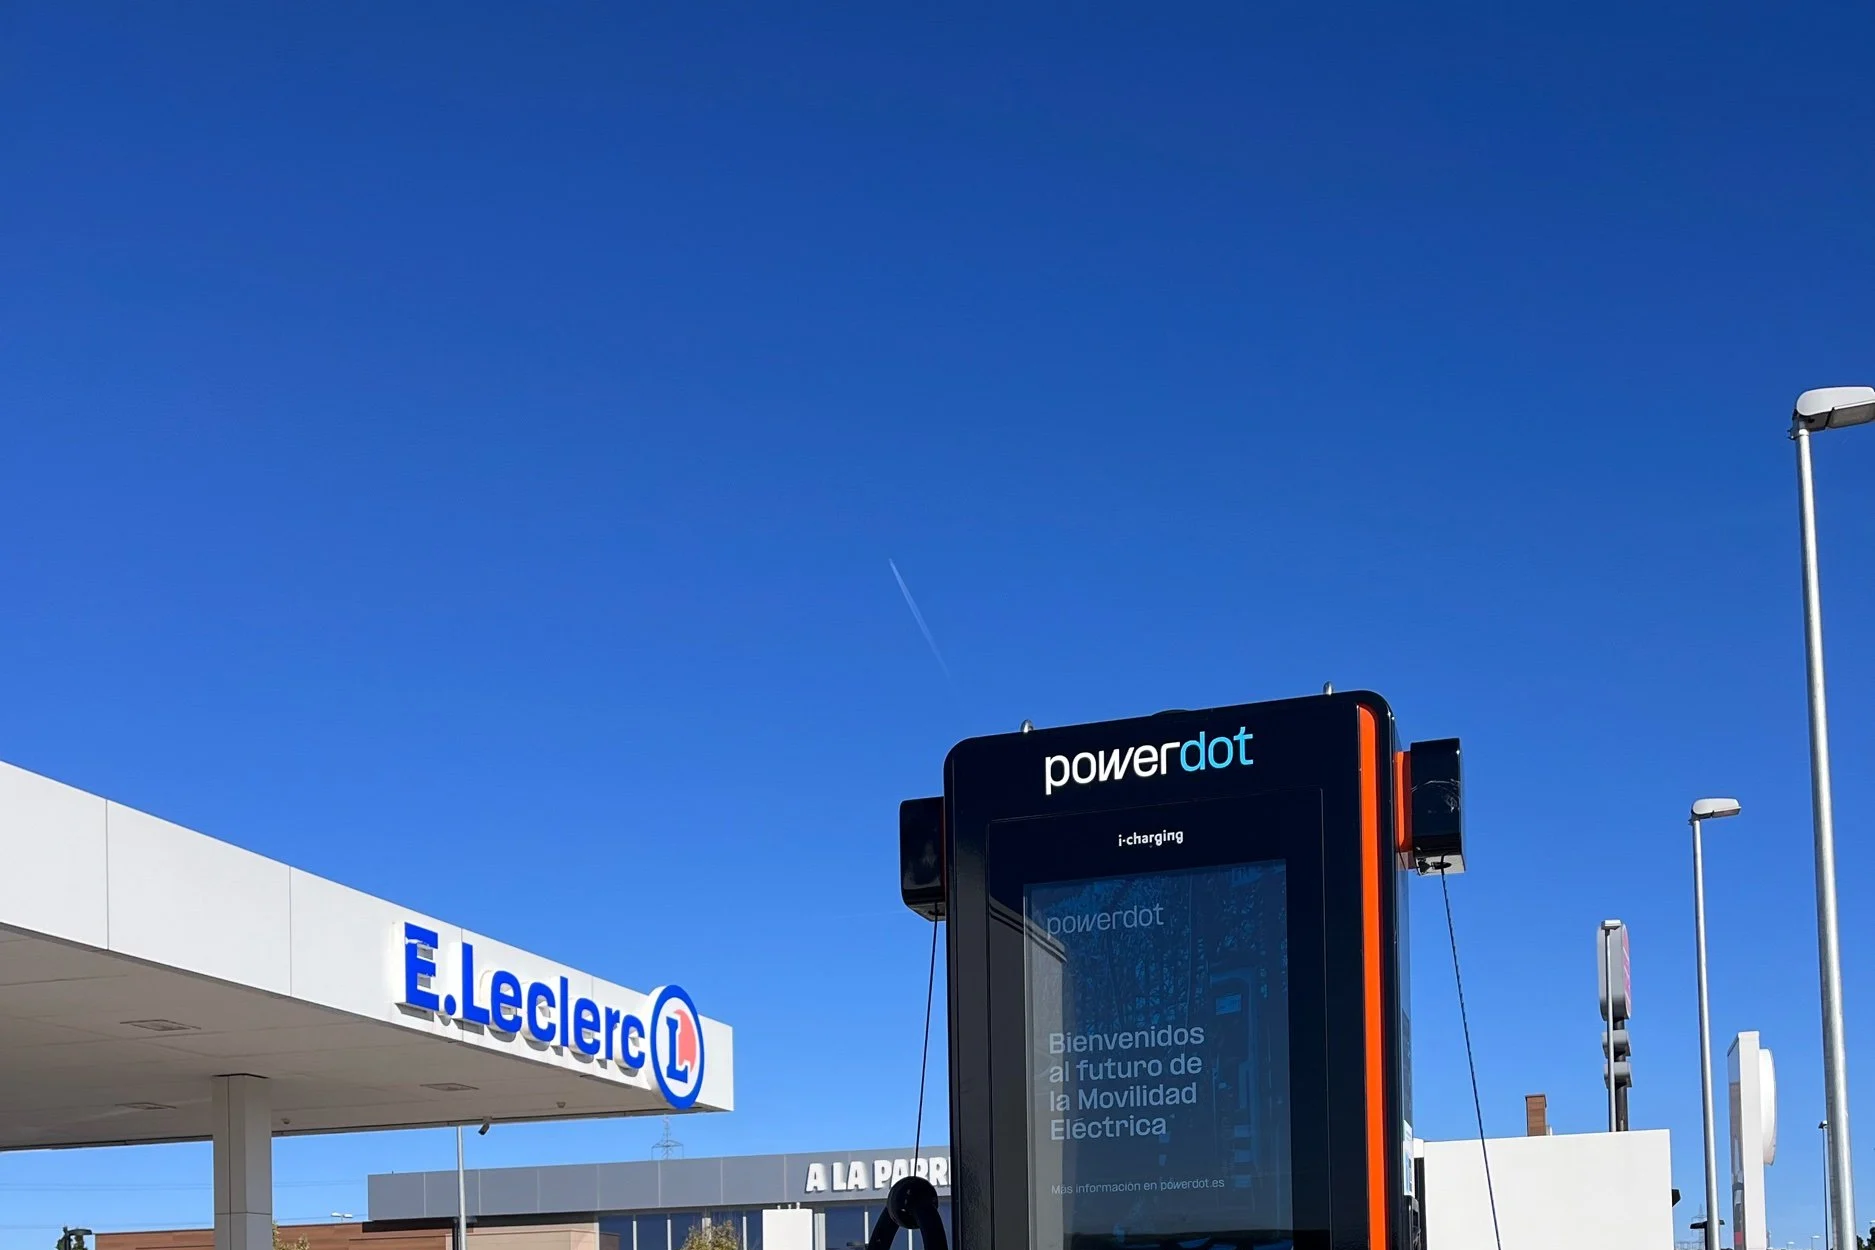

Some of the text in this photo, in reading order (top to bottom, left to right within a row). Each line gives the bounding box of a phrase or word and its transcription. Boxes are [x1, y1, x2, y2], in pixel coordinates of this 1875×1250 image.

[1045, 726, 1254, 795] powerdot
[1047, 902, 1164, 939] powerdot
[403, 921, 646, 1070] E.Leclerc
[1050, 1025, 1205, 1055] Bienvenidos
[1050, 1053, 1202, 1083] al futuro de
[1050, 1082, 1197, 1112] la Movilidad
[1051, 1115, 1167, 1141] Eléctrica
[805, 1156, 951, 1192] A LA PARR
[1143, 1181, 1158, 1192] en
[1160, 1177, 1225, 1192] powerdot.es
